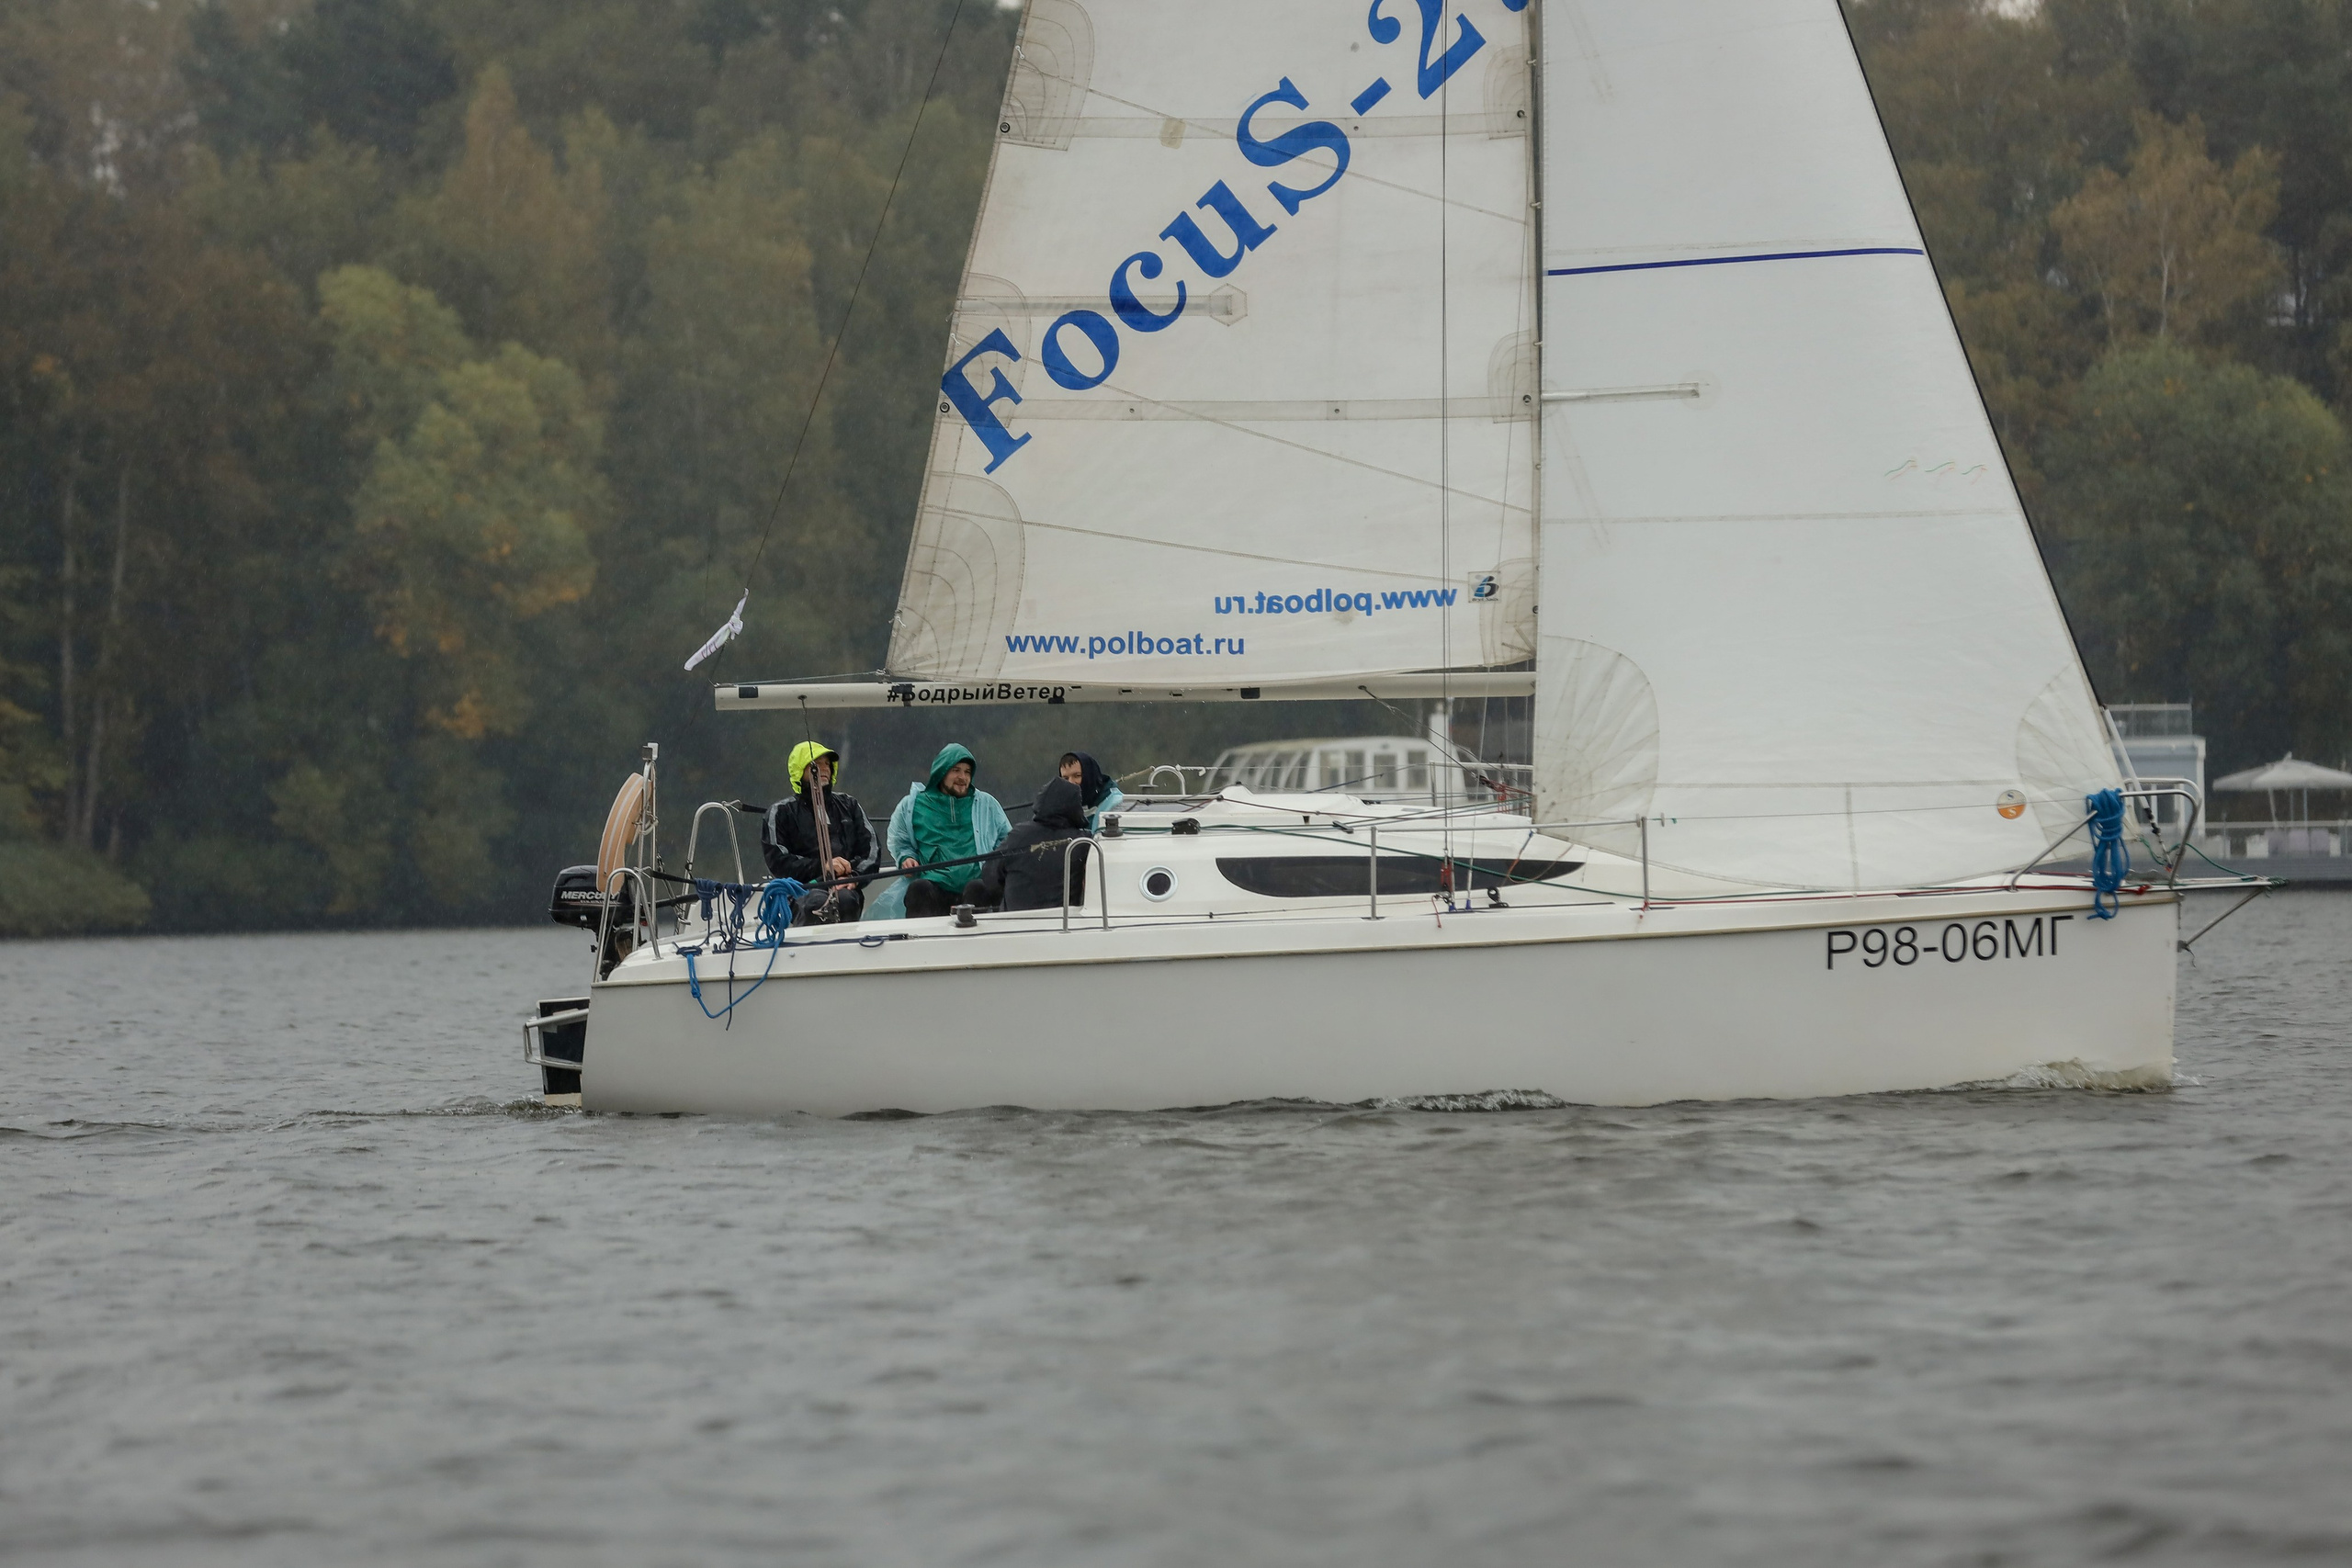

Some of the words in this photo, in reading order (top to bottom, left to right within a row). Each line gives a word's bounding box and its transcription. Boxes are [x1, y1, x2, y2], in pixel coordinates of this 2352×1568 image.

[941, 0, 1529, 475] FocuS-2
[1005, 630, 1245, 659] www.polboat.ru
[1827, 915, 2074, 970] Р98-06МГ
